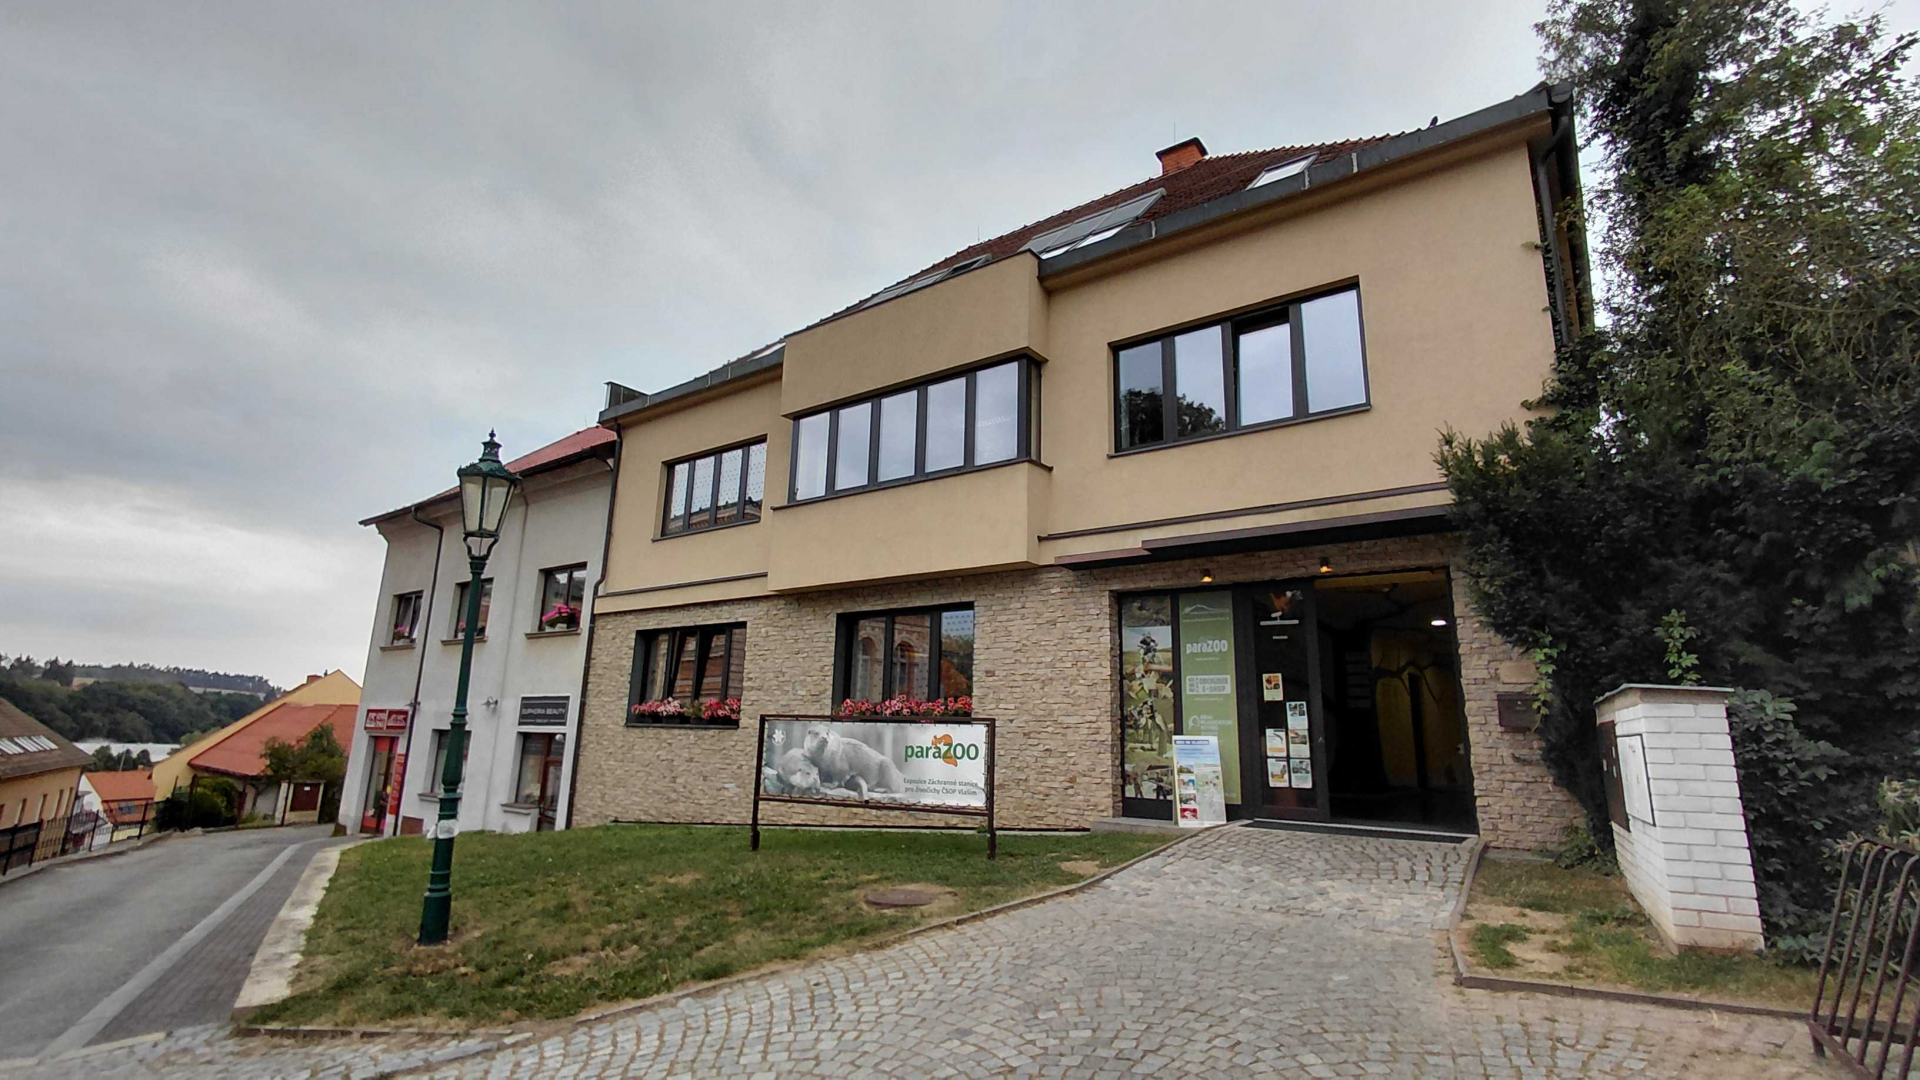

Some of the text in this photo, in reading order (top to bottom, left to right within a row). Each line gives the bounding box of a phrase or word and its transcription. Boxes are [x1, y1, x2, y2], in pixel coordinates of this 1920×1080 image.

[1186, 639, 1228, 655] paraZOO
[904, 742, 980, 763] paraZOO
[928, 778, 958, 786] Záchranné
[958, 780, 979, 788] stanice
[915, 786, 940, 795] živočichy
[941, 786, 957, 795] ČSOP
